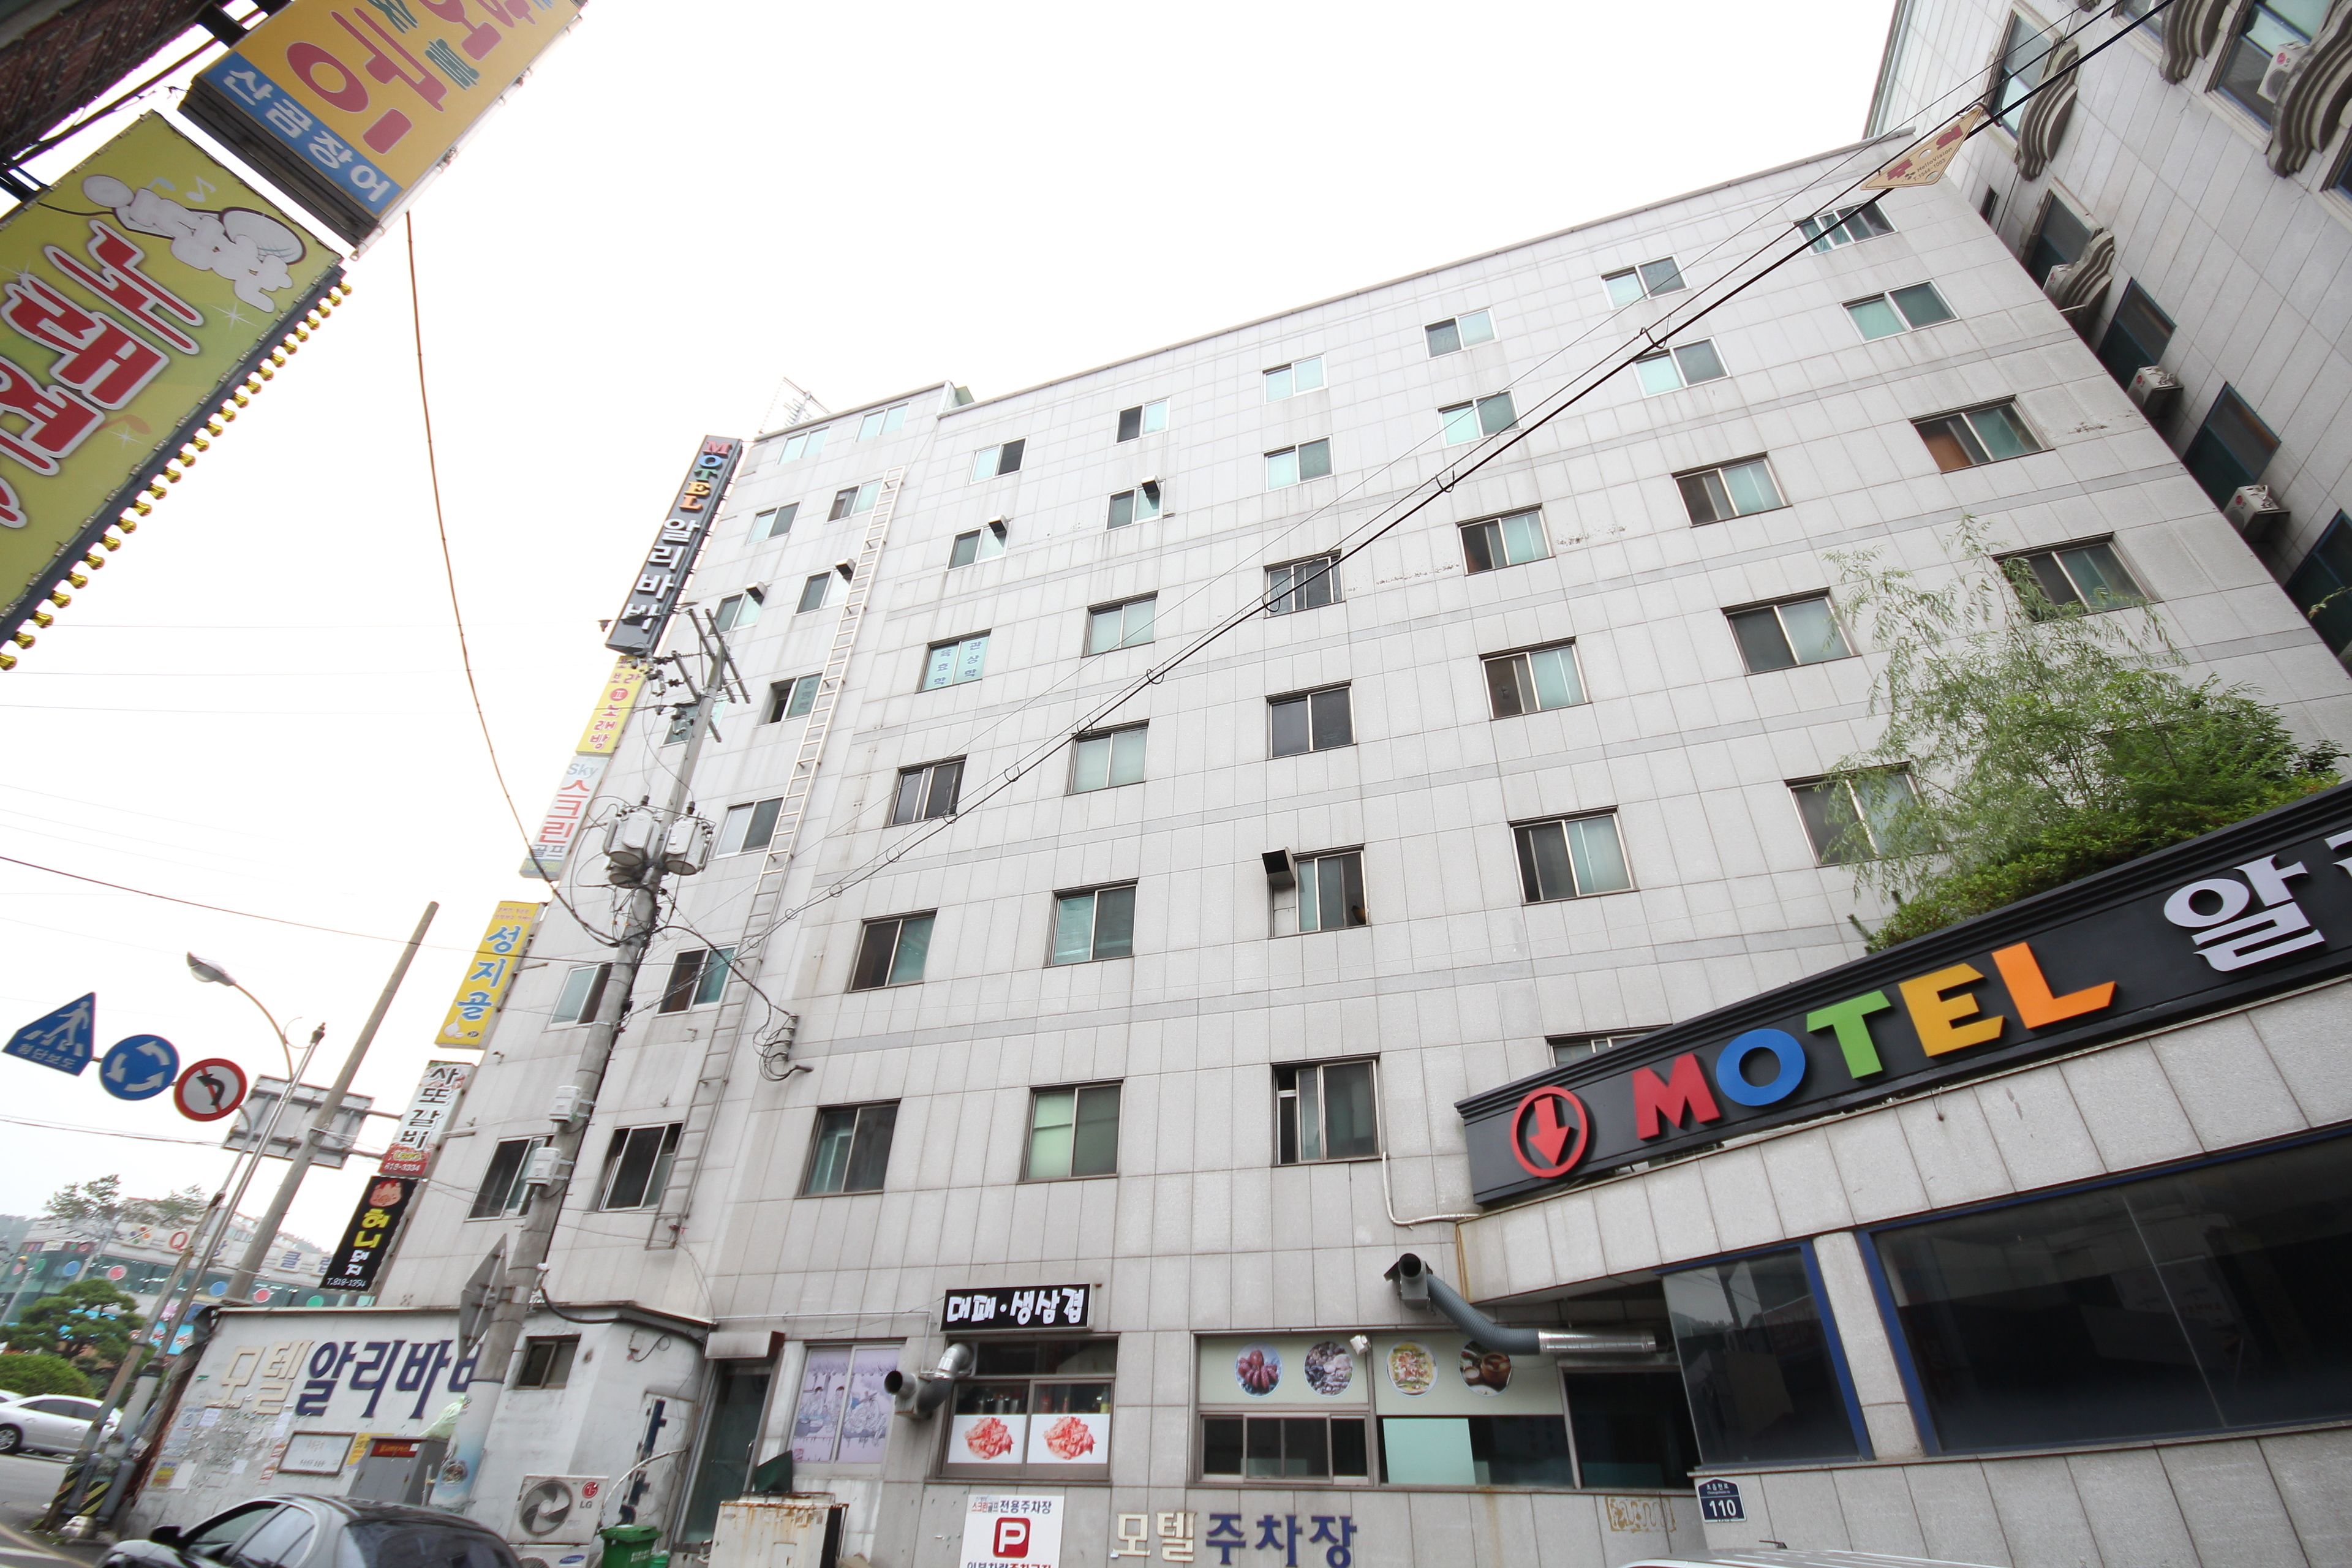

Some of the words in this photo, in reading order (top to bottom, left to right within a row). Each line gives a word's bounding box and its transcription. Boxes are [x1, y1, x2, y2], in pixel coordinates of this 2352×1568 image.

[287, 6, 448, 154] 구이
[223, 68, 393, 202] 산곰장어
[1917, 146, 1953, 173] HelloVision
[679, 440, 733, 511] MOTEL
[622, 518, 701, 631] 알리바바
[590, 704, 620, 750] 노래방
[567, 763, 599, 778] Sky
[538, 779, 590, 845] 스크린
[531, 845, 565, 858] 골프
[456, 925, 520, 1022] 성지골
[1632, 941, 2116, 1142] MOTEL
[399, 1068, 459, 1150] 사또갈비
[353, 1208, 391, 1248] 허니
[205, 1340, 315, 1415] 모텔
[579, 1501, 592, 1509] LG
[999, 1500, 1052, 1515] 전용주차장
[1709, 1499, 1736, 1517] 110
[998, 1522, 1028, 1553] P
[1115, 1511, 1197, 1562] 모텔
[1205, 1513, 1358, 1568] 주차장
